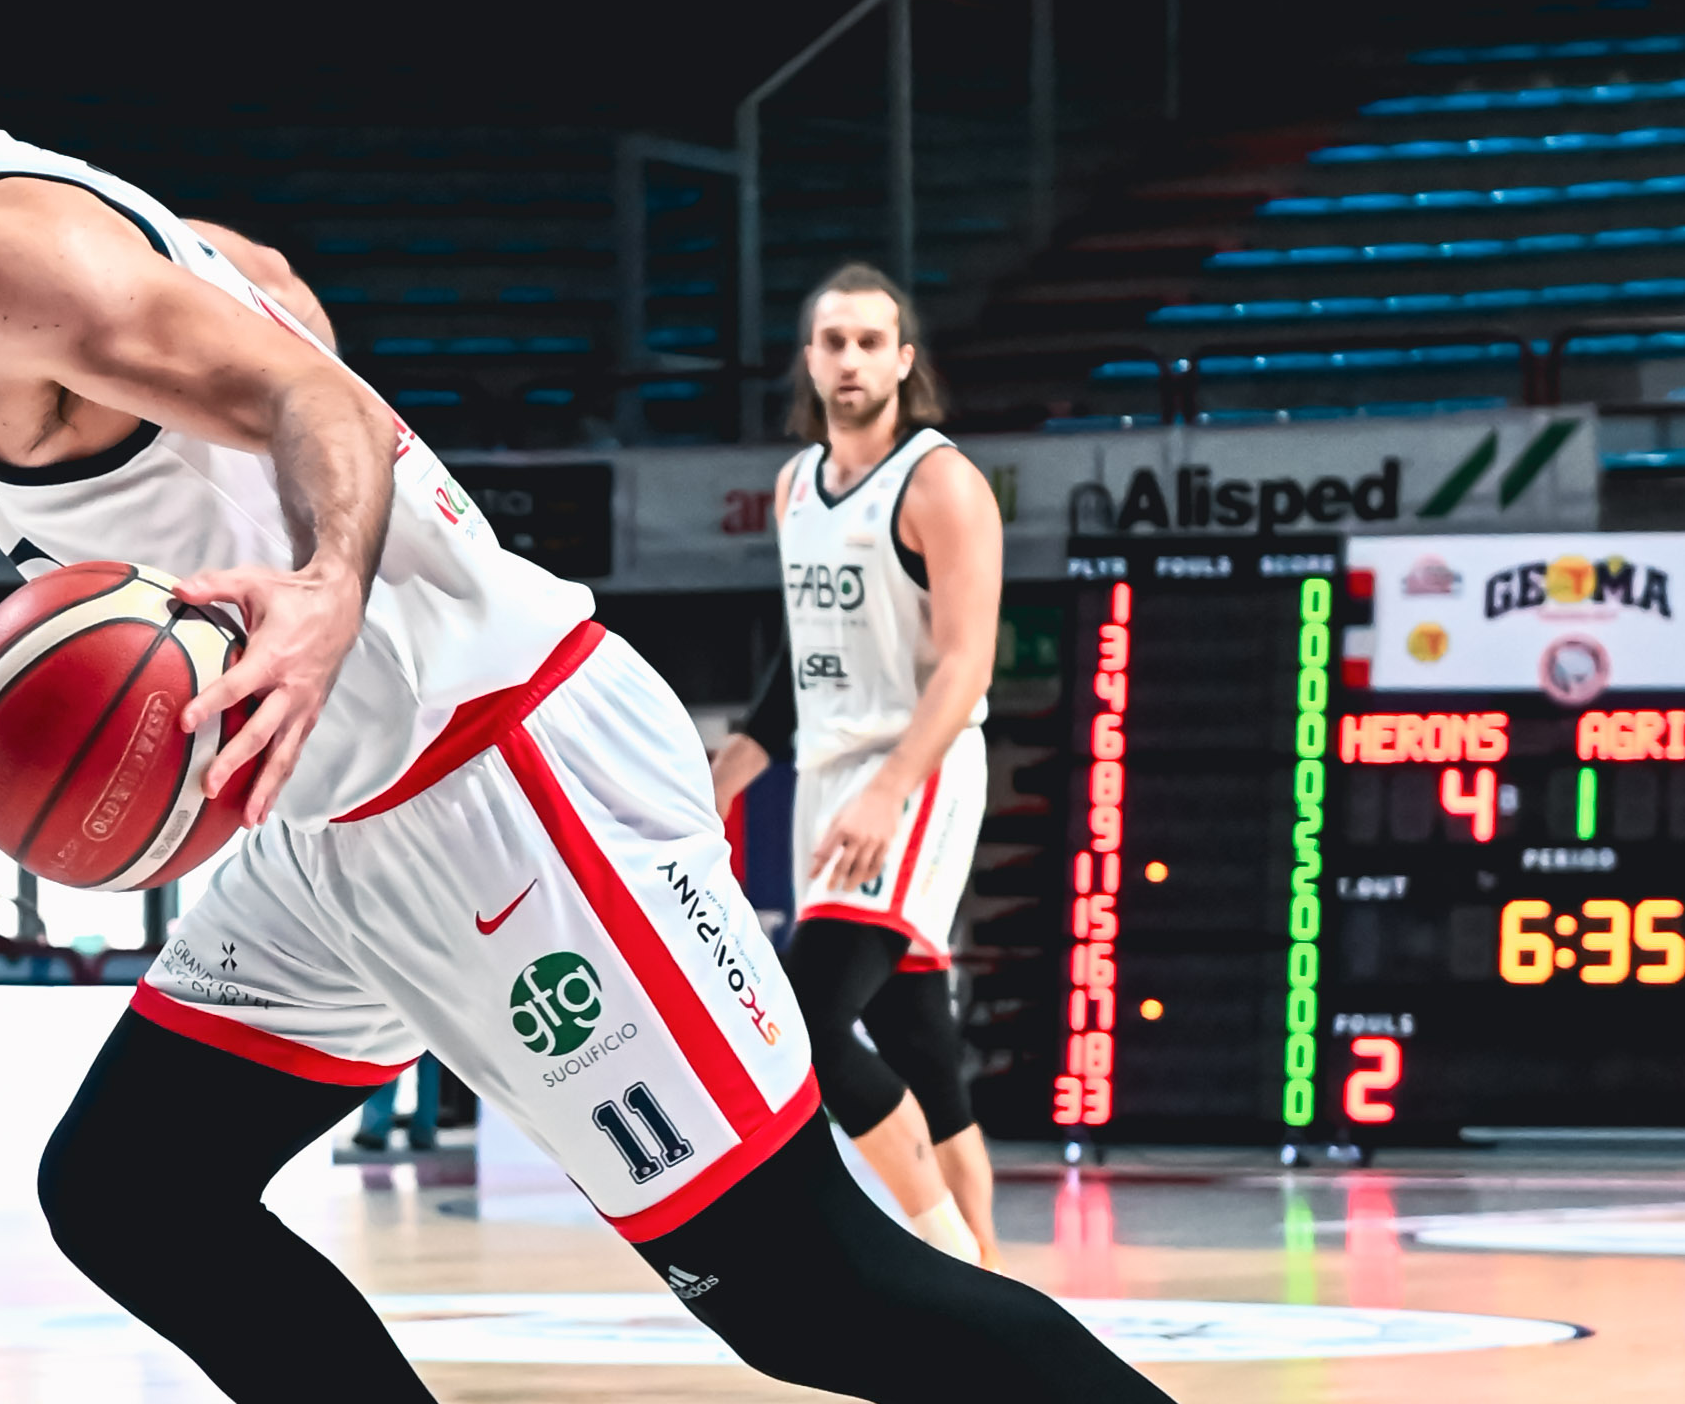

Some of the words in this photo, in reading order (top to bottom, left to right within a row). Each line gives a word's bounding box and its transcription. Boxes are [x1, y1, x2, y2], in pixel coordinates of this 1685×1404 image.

[1117, 457, 1401, 534] Alisped
[1113, 581, 1131, 625] 1
[1300, 578, 1332, 624] 0
[1099, 624, 1130, 671] 3
[1299, 623, 1330, 668] 0
[1094, 671, 1128, 714] 4
[1298, 667, 1328, 713] 0
[1092, 713, 1125, 760] 6
[1296, 712, 1326, 759] 0
[1339, 711, 1510, 764] HERONS
[1091, 761, 1124, 807] 8
[1294, 759, 1325, 804] 0
[1439, 767, 1497, 843] 4
[1577, 767, 1597, 840] 1
[1090, 805, 1122, 853] 9
[1074, 851, 1120, 894] 11
[1073, 894, 1118, 941] 15
[1289, 894, 1320, 941] 0
[1071, 941, 1115, 988] 16
[1288, 941, 1319, 986] 0
[1499, 899, 1685, 985] 6:35
[512, 964, 603, 1056] gfg
[1069, 987, 1114, 1031] 17
[1287, 986, 1317, 1031] 0
[542, 1023, 638, 1088] SUOLIFICIO
[1068, 1031, 1113, 1077] 18
[1285, 1031, 1315, 1078] 0
[1053, 1076, 1113, 1125] 33
[1283, 1077, 1314, 1126] 0
[1344, 1036, 1403, 1124] 2
[592, 1081, 695, 1185] 11
